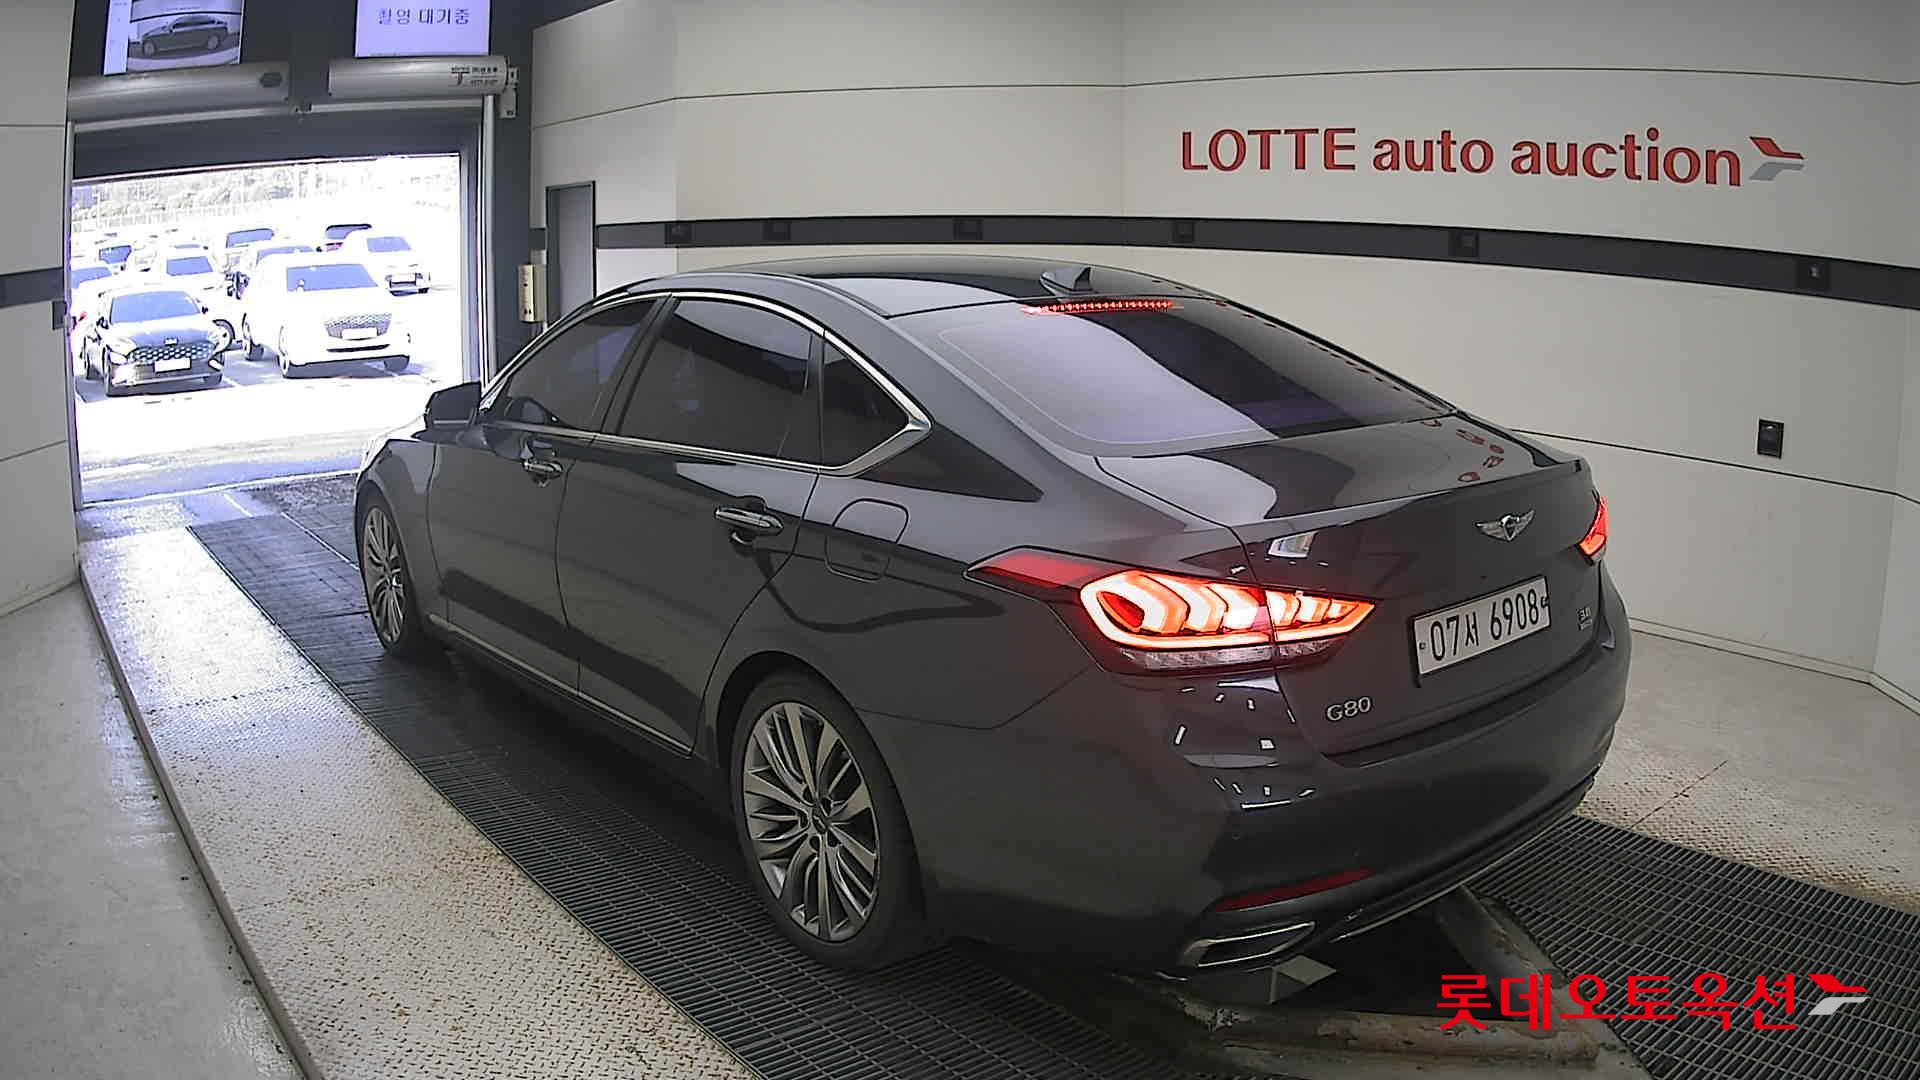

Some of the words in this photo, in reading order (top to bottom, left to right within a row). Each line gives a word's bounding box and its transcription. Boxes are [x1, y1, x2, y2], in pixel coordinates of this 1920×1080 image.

[419, 8, 470, 25] 대기중
[1181, 128, 1357, 171] LOTTE
[1373, 130, 1494, 172] auto
[1511, 127, 1742, 186] auction
[1430, 610, 1480, 661] 07서
[1490, 588, 1539, 640] 6908
[1326, 696, 1373, 722] G80
